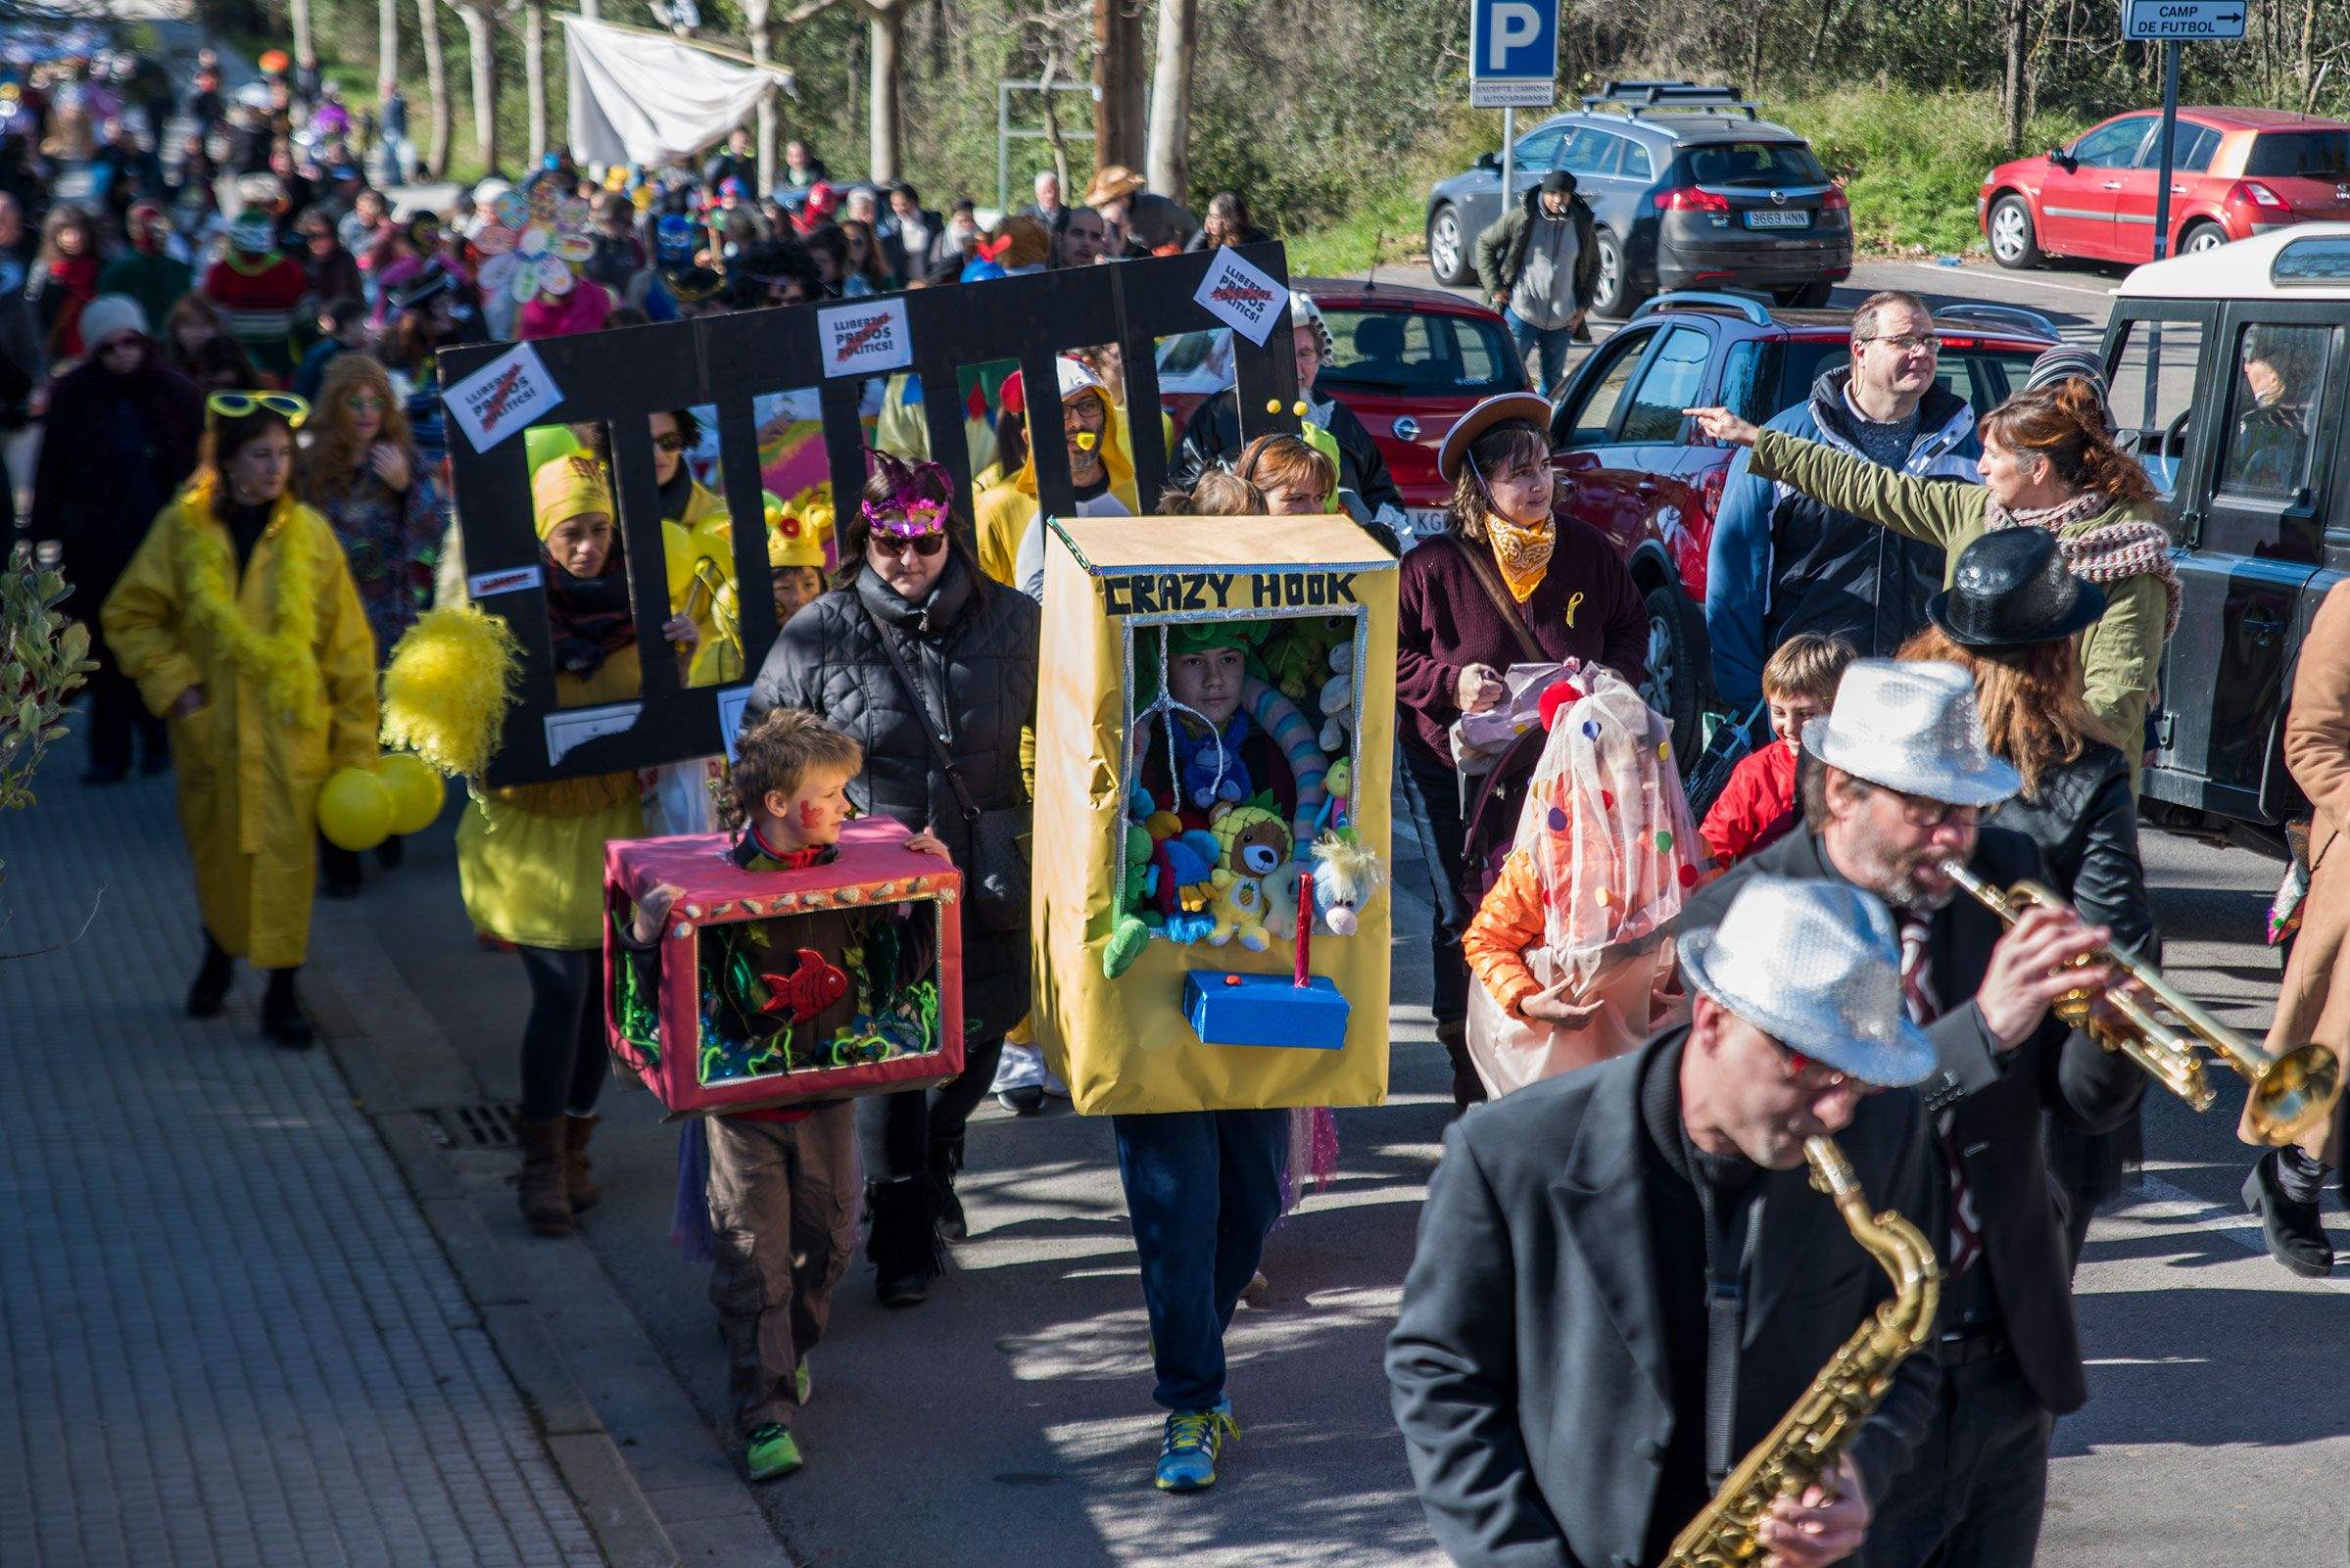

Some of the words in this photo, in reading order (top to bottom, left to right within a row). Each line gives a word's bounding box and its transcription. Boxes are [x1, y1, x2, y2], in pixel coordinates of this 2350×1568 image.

[2159, 6, 2198, 18] CAMP
[2138, 22, 2156, 32] DE
[2161, 22, 2215, 33] FUTBOL
[1489, 3, 1541, 70] P
[1752, 212, 1781, 225] 9669
[1783, 212, 1805, 225] HNN
[1103, 573, 1234, 616] CRAZY
[1252, 572, 1358, 608] HOOK
